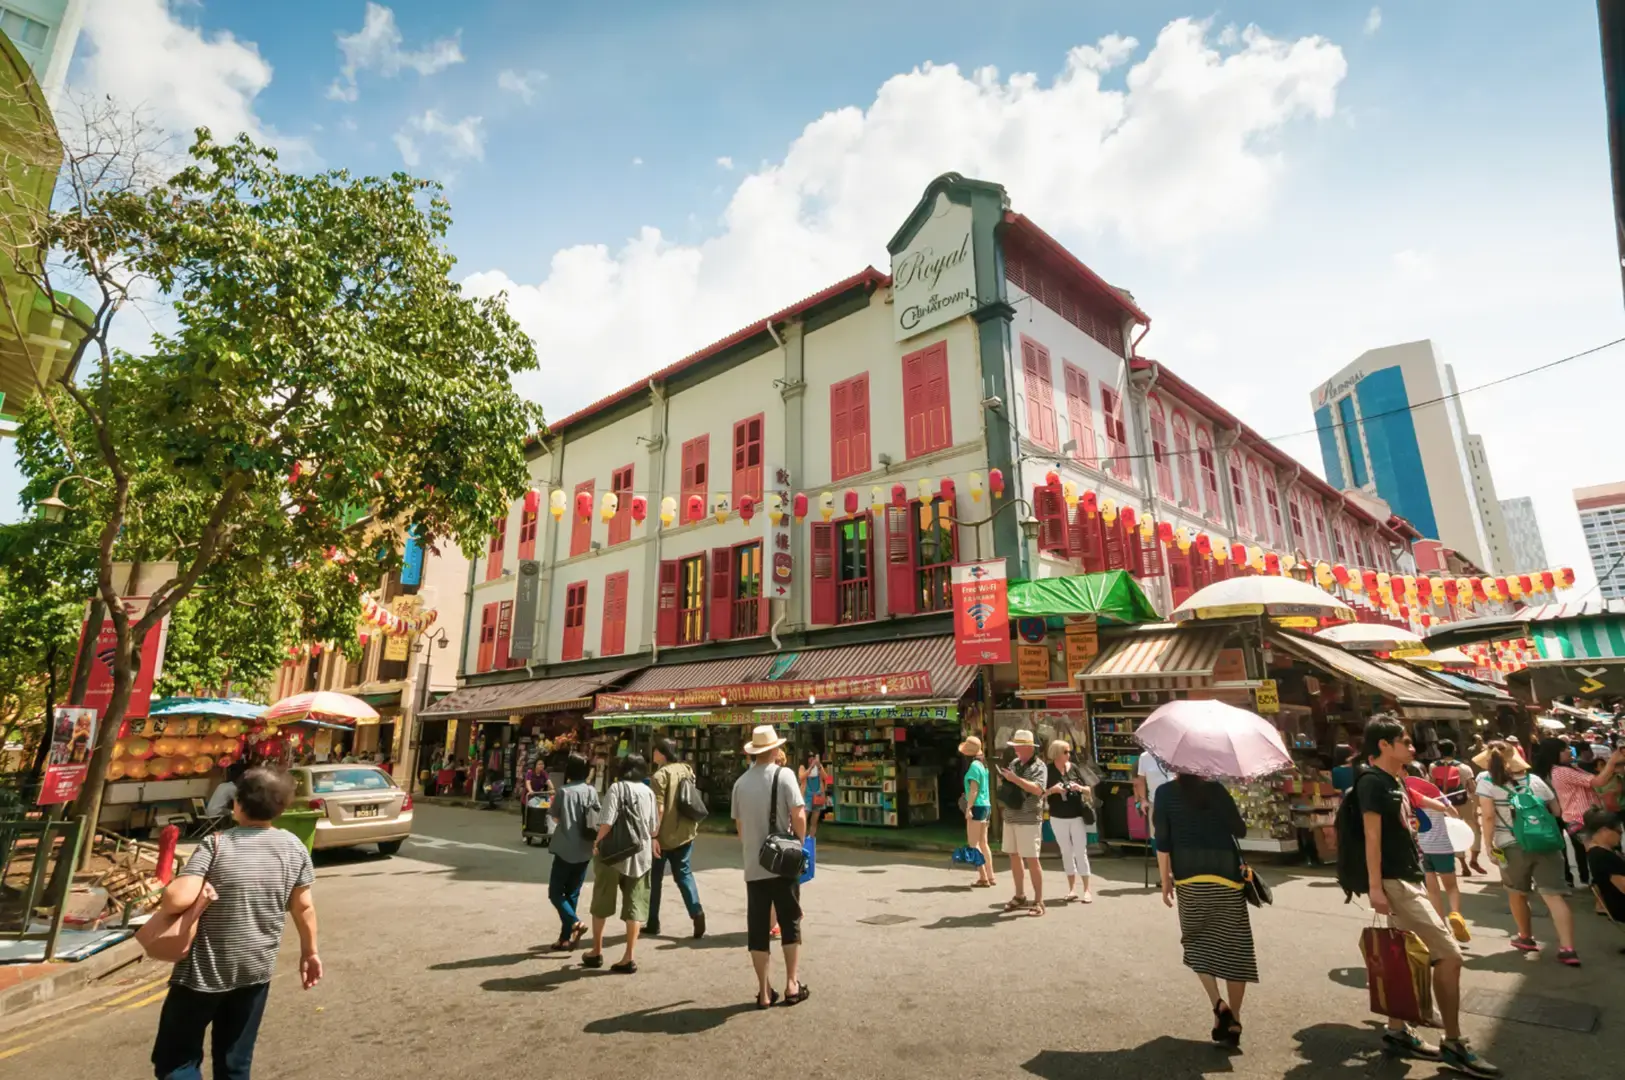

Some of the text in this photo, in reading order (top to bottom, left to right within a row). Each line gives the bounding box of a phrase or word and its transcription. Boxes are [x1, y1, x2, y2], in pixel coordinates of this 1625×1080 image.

[895, 233, 969, 291] Royal
[900, 288, 970, 330] CHINATOWN
[962, 583, 997, 594] Free Wi-Fi
[749, 685, 780, 698] AWARD
